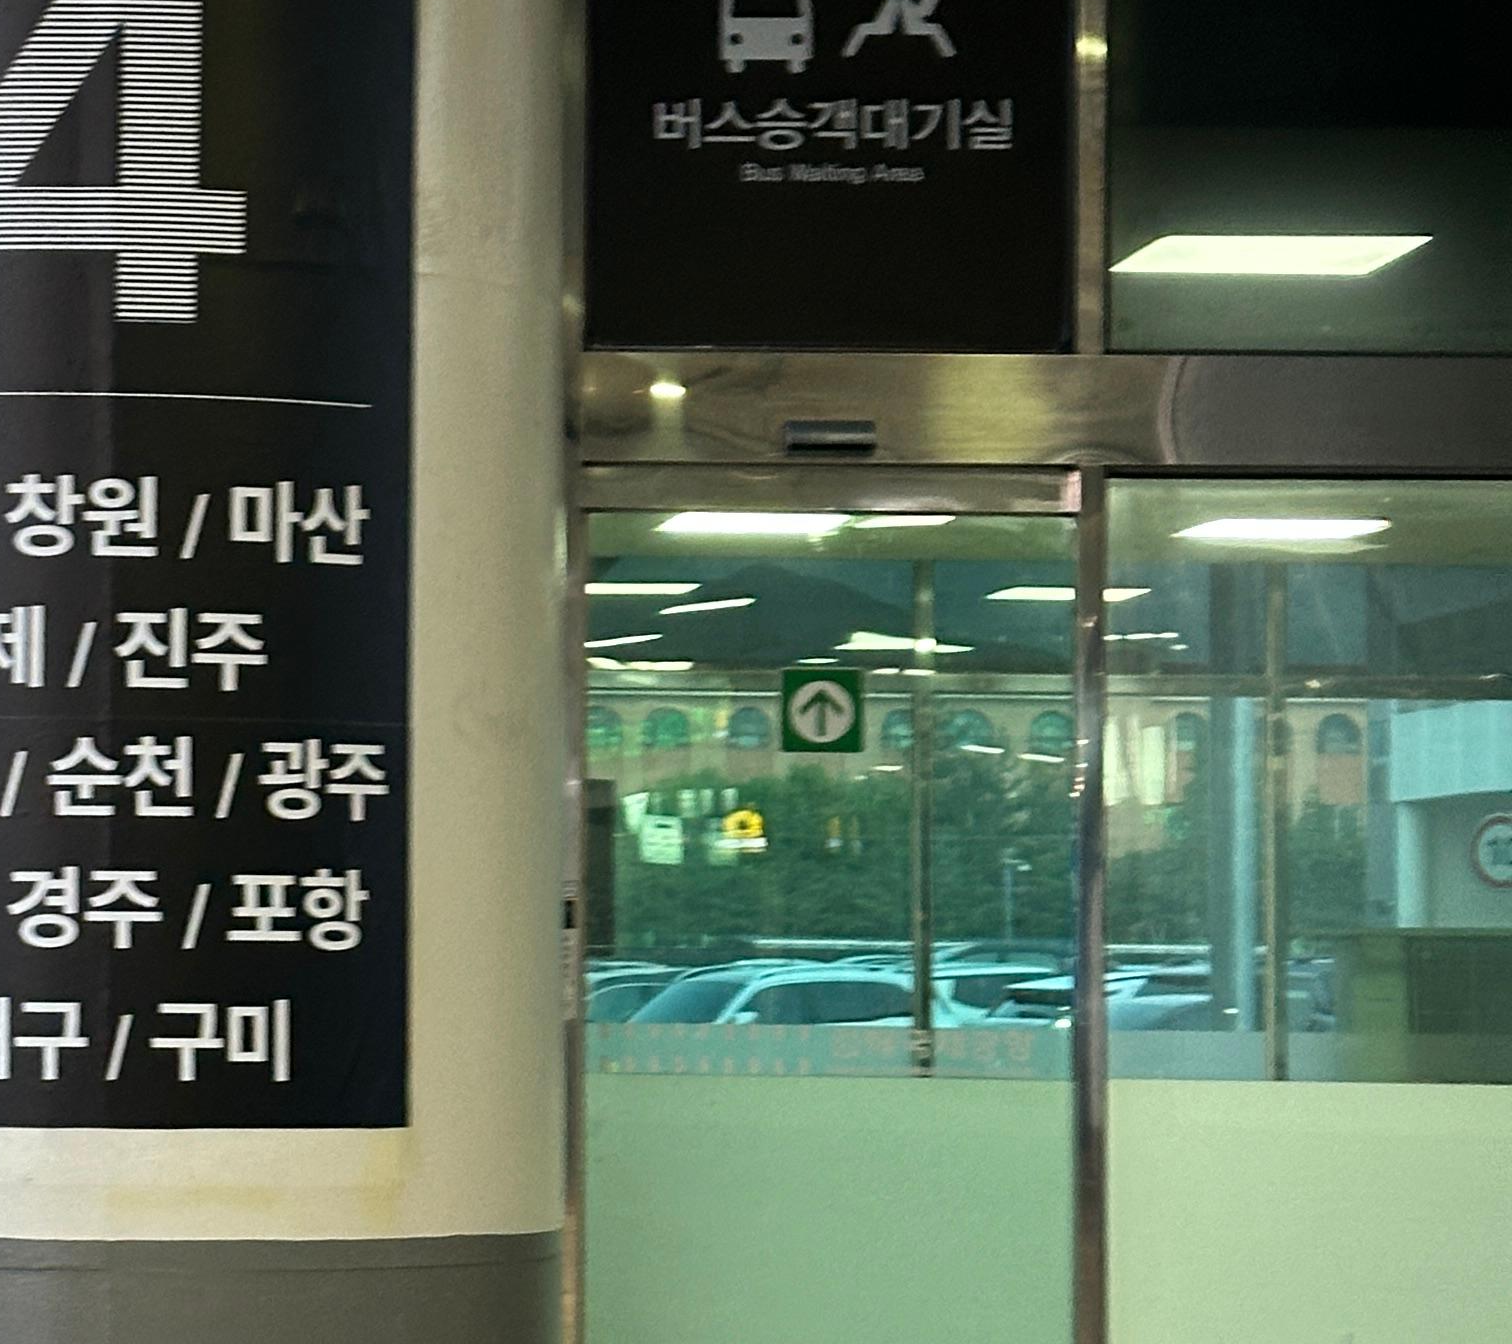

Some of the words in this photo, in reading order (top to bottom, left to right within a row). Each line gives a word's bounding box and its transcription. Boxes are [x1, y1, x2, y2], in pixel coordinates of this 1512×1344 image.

[652, 99, 1012, 150] 버스승객대기실
[740, 162, 784, 181] Bus
[790, 163, 867, 184] Waiting
[872, 163, 925, 182] Area
[5, 474, 157, 556] 창원
[181, 494, 208, 558] /
[231, 482, 368, 564] 마산
[67, 622, 96, 687] /
[115, 608, 266, 691] 진주
[0, 751, 27, 816] /
[47, 736, 192, 816] 순천
[216, 754, 242, 818] /
[259, 739, 388, 821] 광주
[7, 866, 162, 948] 경주
[183, 884, 209, 949] /
[228, 869, 368, 950] 포항
[106, 1015, 132, 1080] /
[150, 1000, 288, 1081] 구미
